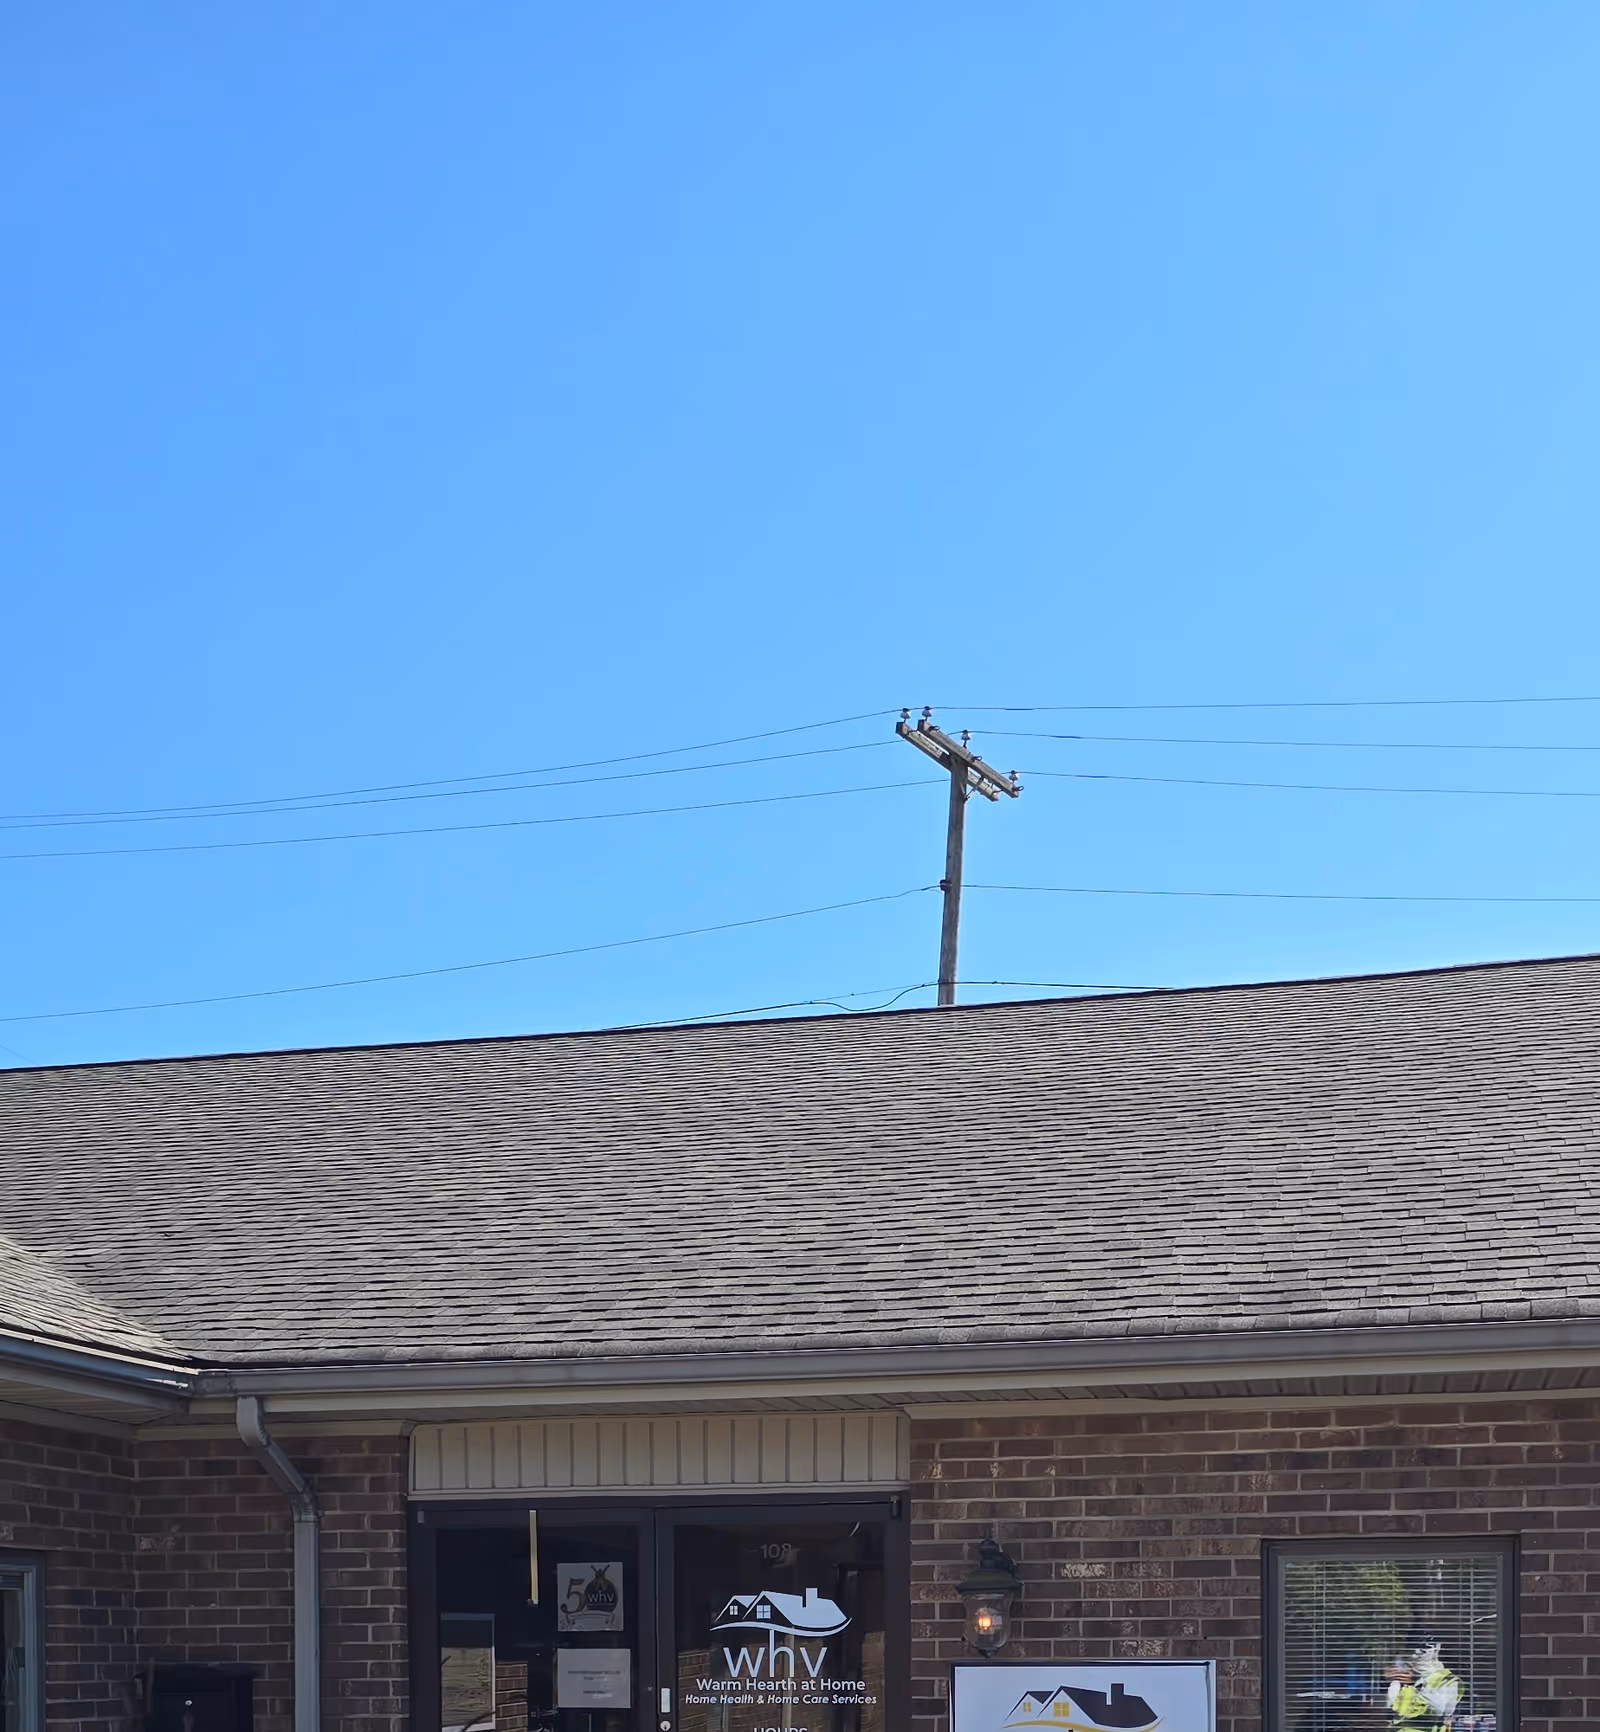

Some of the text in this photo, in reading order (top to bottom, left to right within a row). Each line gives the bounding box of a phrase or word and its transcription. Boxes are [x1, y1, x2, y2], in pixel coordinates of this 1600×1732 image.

[723, 1629, 828, 1678] whv
[696, 1678, 866, 1691] Warm Hearth at Home
[685, 1694, 877, 1704] Home Health & Home Care Services
